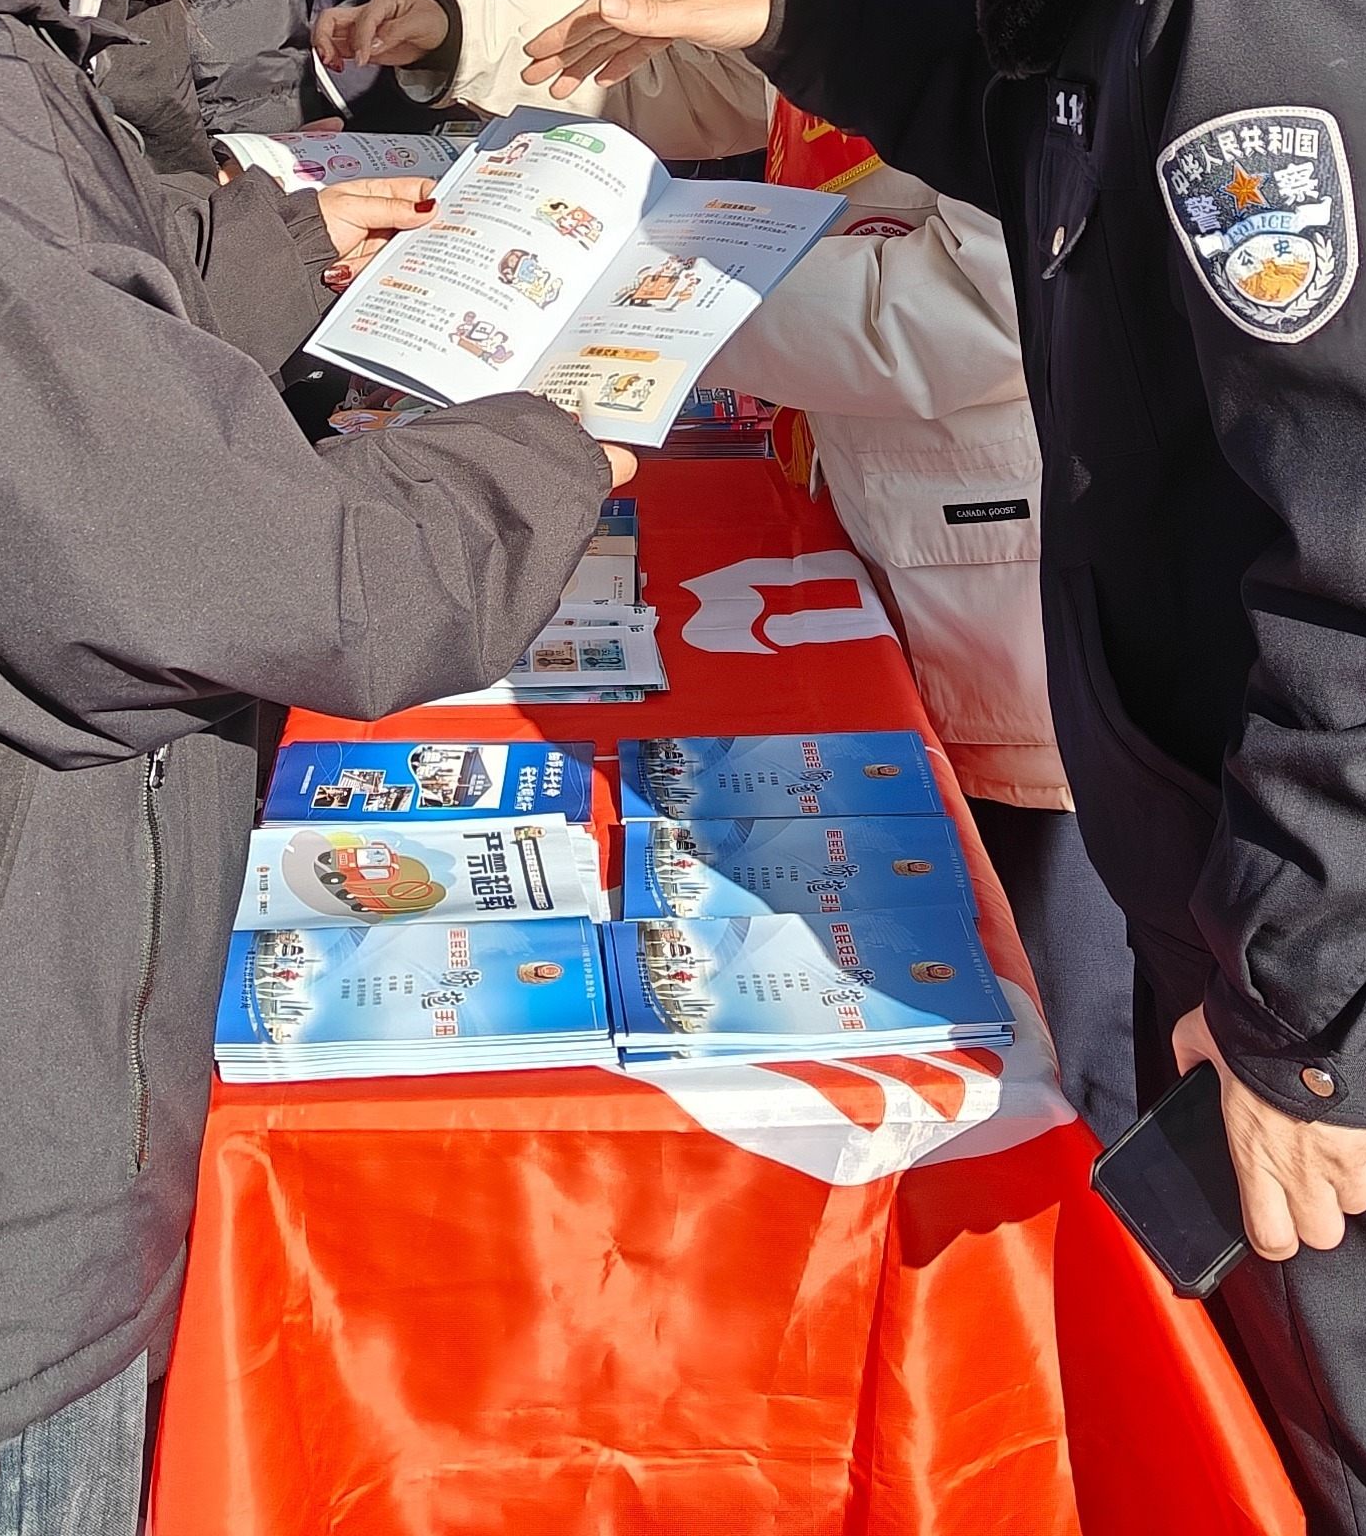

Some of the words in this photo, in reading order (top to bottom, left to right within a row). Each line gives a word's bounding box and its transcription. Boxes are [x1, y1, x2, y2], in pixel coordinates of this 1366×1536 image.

[1171, 125, 1319, 195] 中华人民共和国
[1229, 214, 1293, 243] POLICE
[956, 509, 987, 518] CANADA
[988, 506, 1017, 518] GOOSE
[463, 831, 518, 911] 严禁超载
[420, 928, 482, 1037] 居民安全防范手册
[819, 922, 876, 1031] 居民安全防范手册
